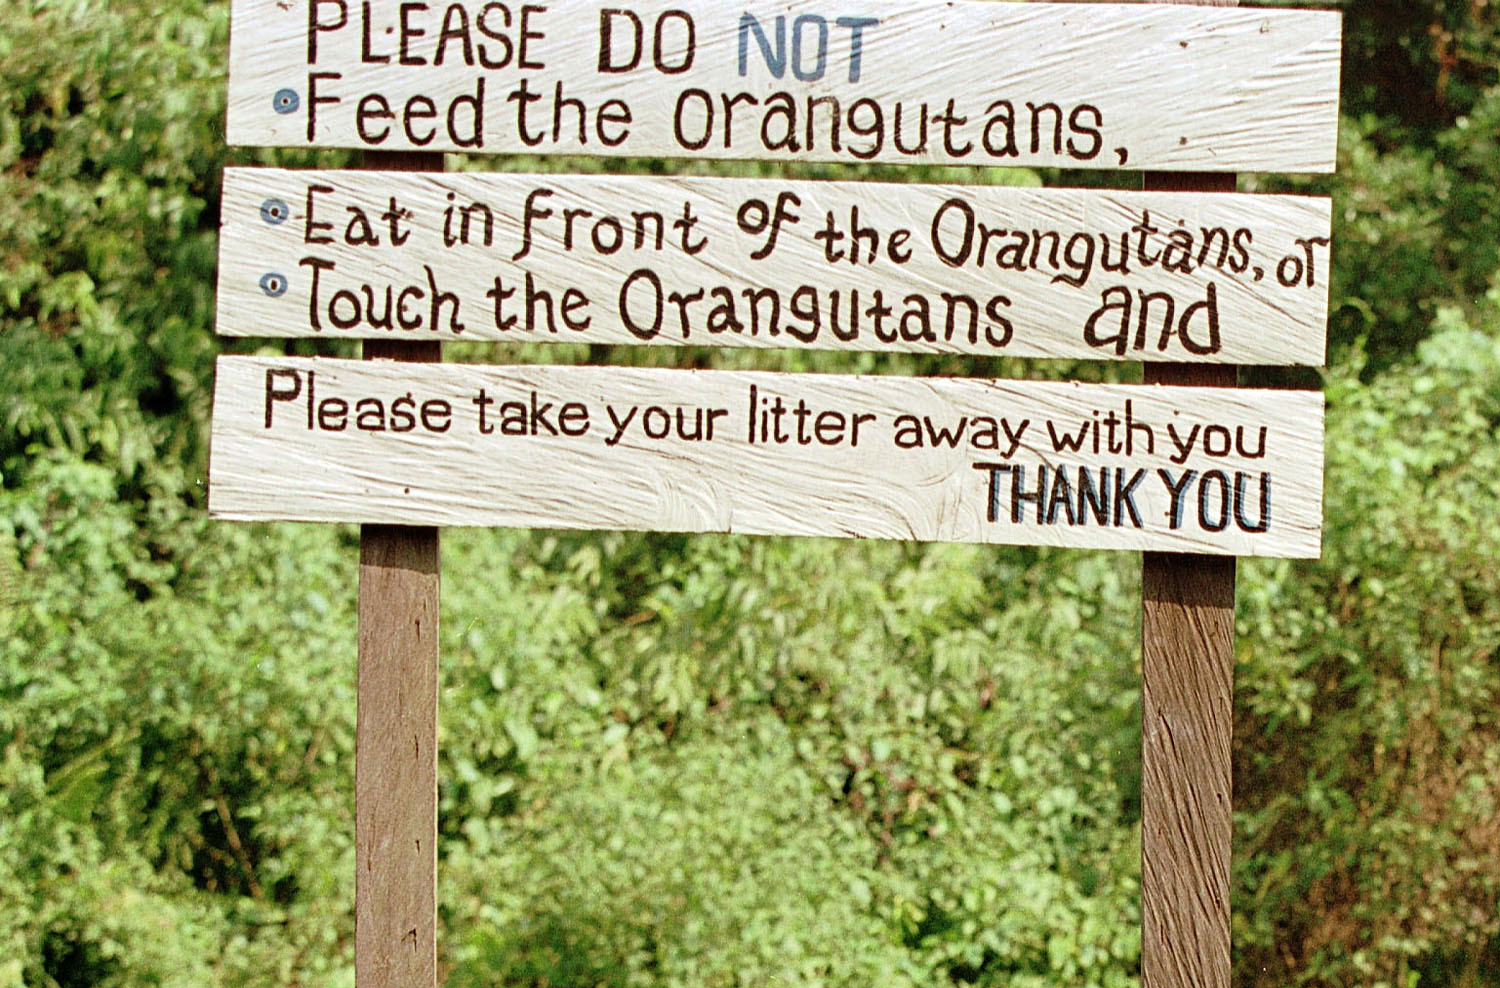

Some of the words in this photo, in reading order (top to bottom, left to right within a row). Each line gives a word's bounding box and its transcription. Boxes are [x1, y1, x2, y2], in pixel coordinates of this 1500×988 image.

[307, 0, 548, 70] PLEASE
[597, 8, 697, 75] DO
[736, 12, 879, 85] NOT
[306, 71, 486, 149] Feed
[506, 77, 633, 146] the
[303, 184, 412, 246] Eat
[442, 191, 494, 247] in
[511, 188, 709, 262] front
[736, 191, 802, 261] of
[814, 204, 912, 265] the
[930, 198, 1265, 288] Orangutans,
[1276, 235, 1330, 289] or
[299, 257, 465, 333] Touch
[486, 270, 592, 334] the
[618, 268, 1013, 349] Orangutans
[1083, 281, 1222, 356] and
[264, 368, 453, 432] Please
[472, 388, 591, 437] take
[605, 404, 730, 446] your
[748, 384, 877, 448] litter
[893, 412, 1031, 458] away
[1046, 398, 1156, 457] with
[1166, 422, 1268, 465] you
[972, 461, 1147, 530] THANK
[1157, 467, 1272, 534] YOU
